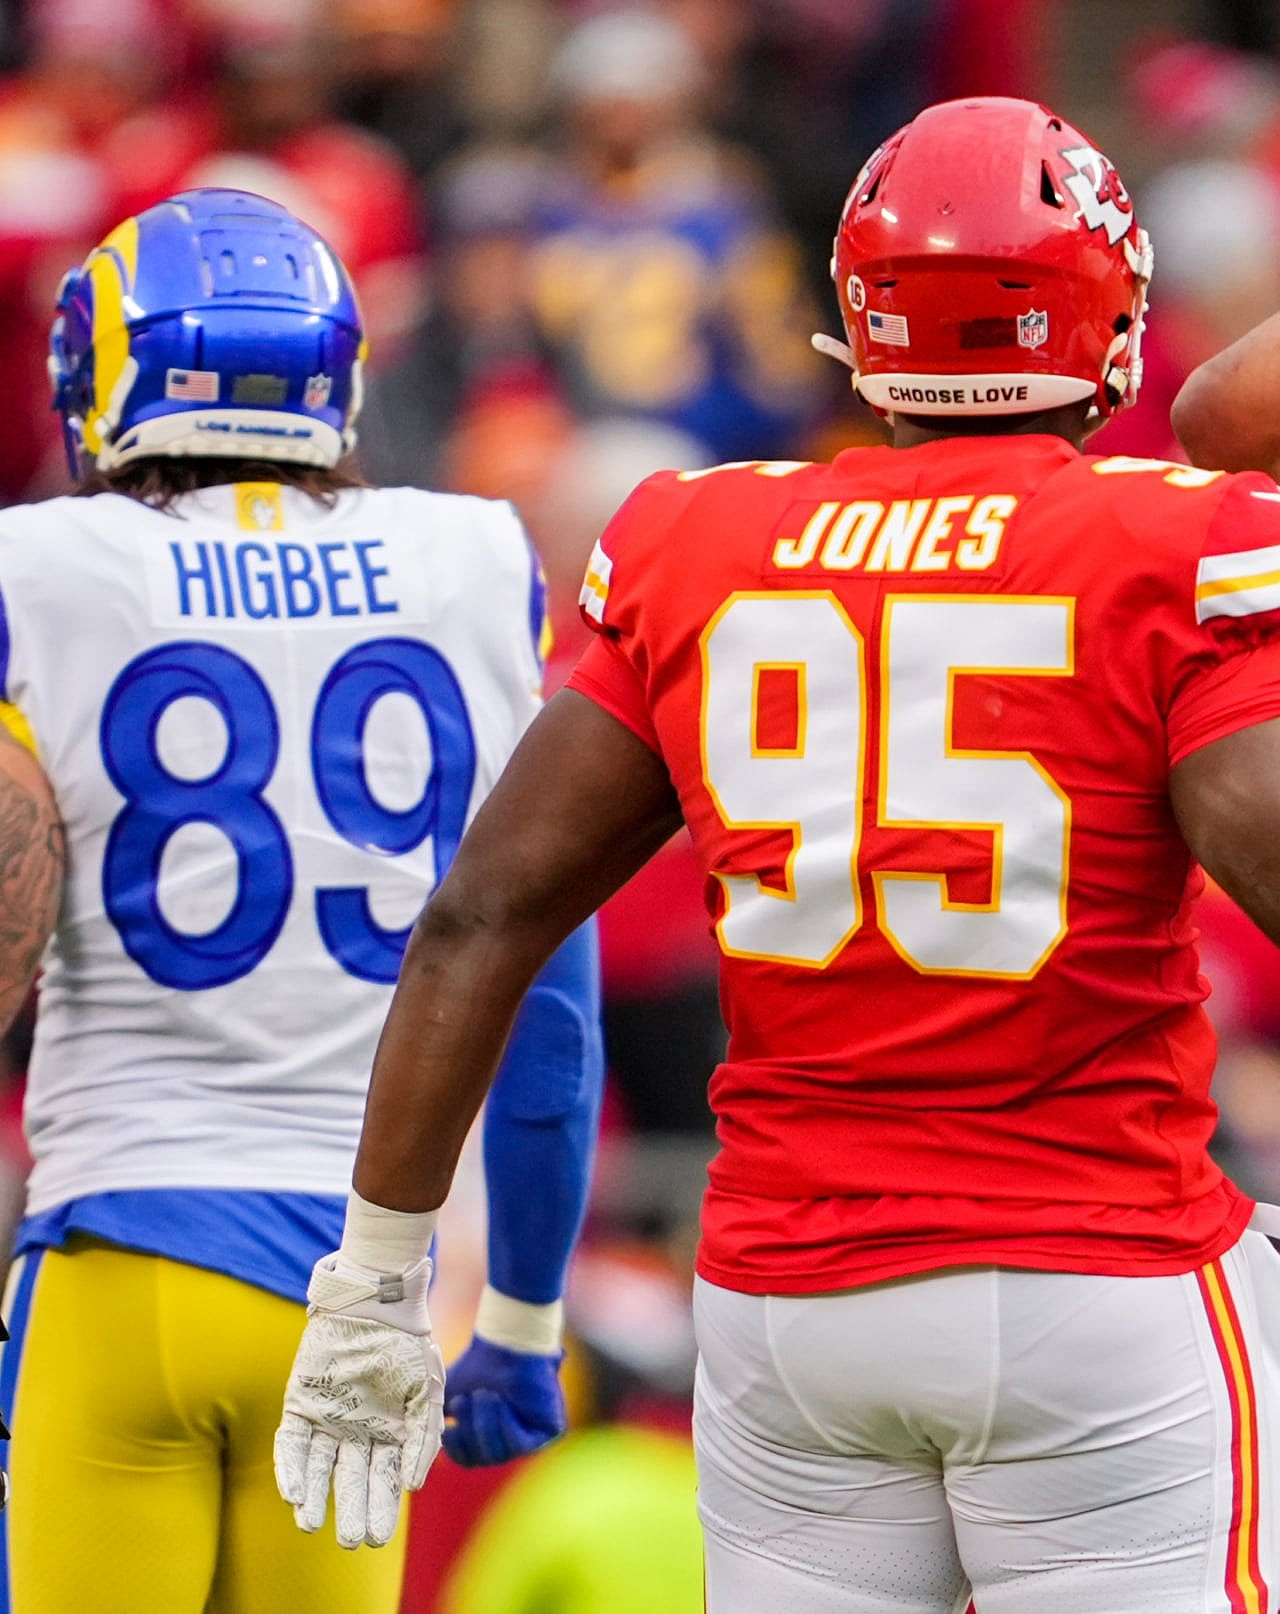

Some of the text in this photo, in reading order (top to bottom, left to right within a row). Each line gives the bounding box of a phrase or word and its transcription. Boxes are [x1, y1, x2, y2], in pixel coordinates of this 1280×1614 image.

[850, 279, 862, 307] 16
[1023, 326, 1045, 343] NFL
[888, 386, 1028, 404] CHOOSE LOVE
[773, 494, 1018, 571] JONES
[169, 539, 398, 619] HIGBEE
[100, 636, 476, 990] 89
[698, 590, 1076, 980] 95
